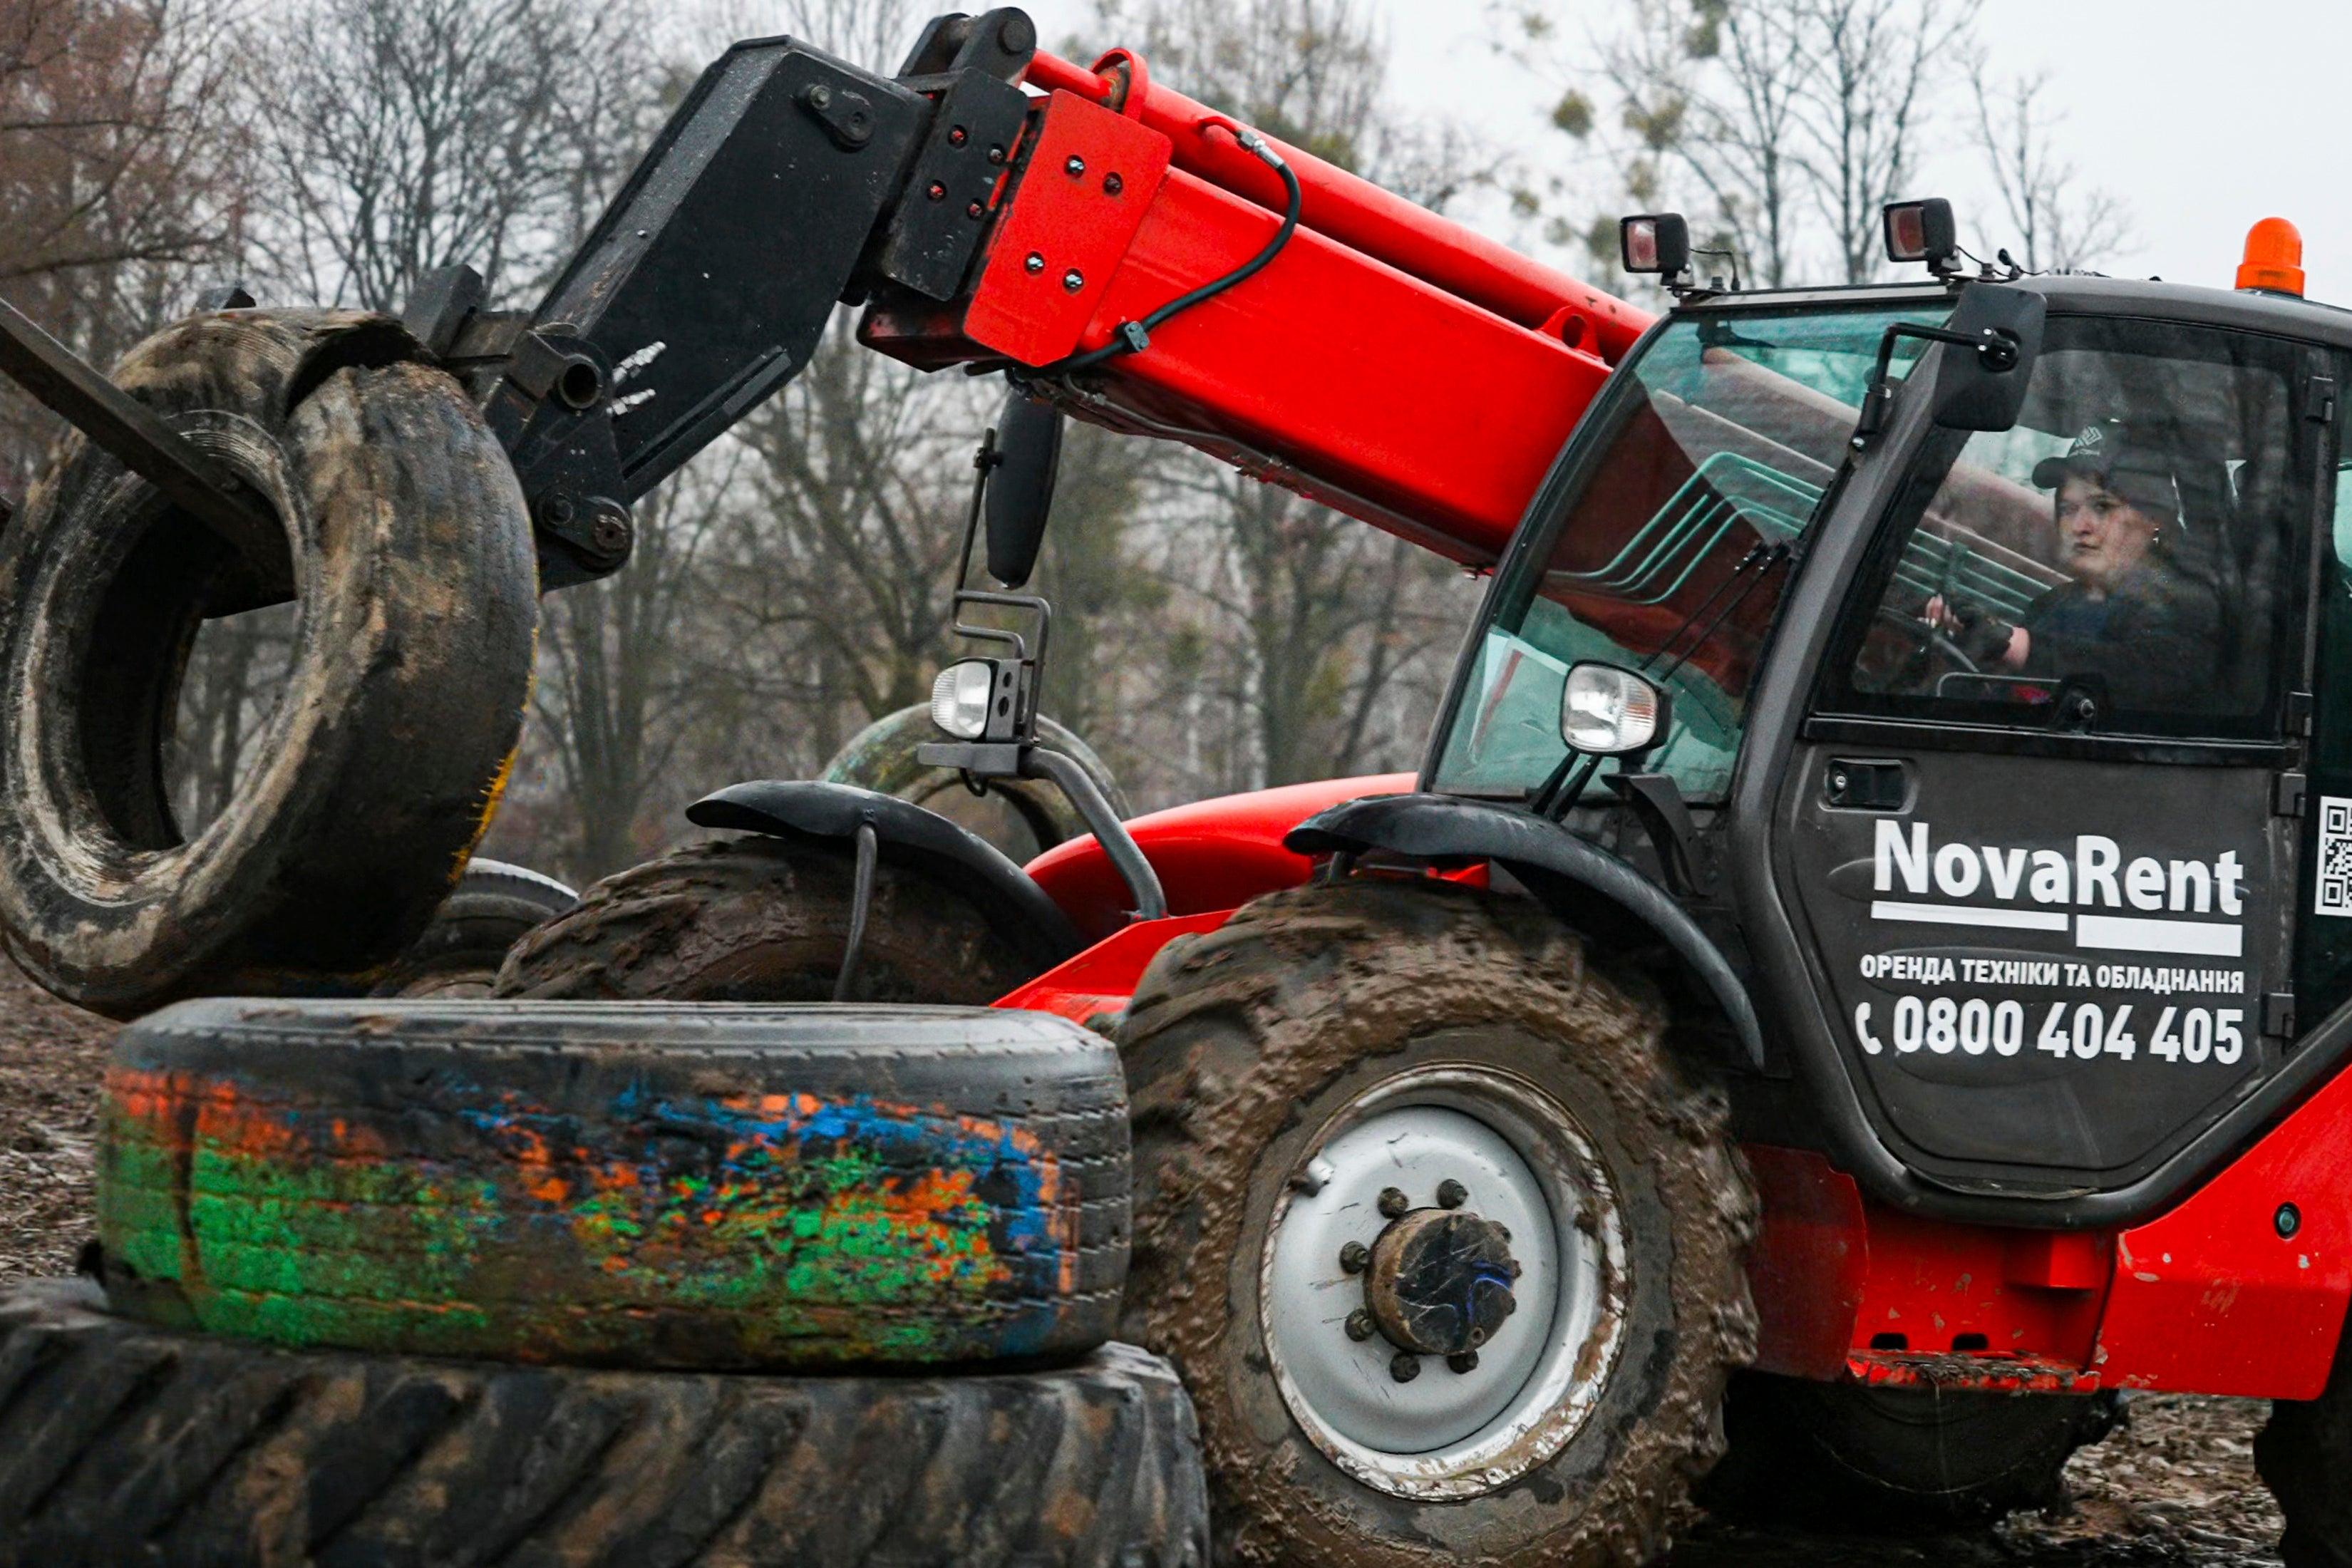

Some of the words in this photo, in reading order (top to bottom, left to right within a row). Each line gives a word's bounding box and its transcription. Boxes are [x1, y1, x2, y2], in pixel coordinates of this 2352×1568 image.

[1874, 819, 2244, 916] NovaRent
[1860, 954, 1956, 985] ОРЕНДА
[1961, 959, 2060, 986] ТЕХНІКИ
[2064, 963, 2093, 988] ТА
[2096, 964, 2244, 995] ОБЛАДНАННЯ
[1893, 996, 2024, 1056] 0800
[2036, 1001, 2136, 1061] 404
[2149, 1006, 2244, 1065] 405
